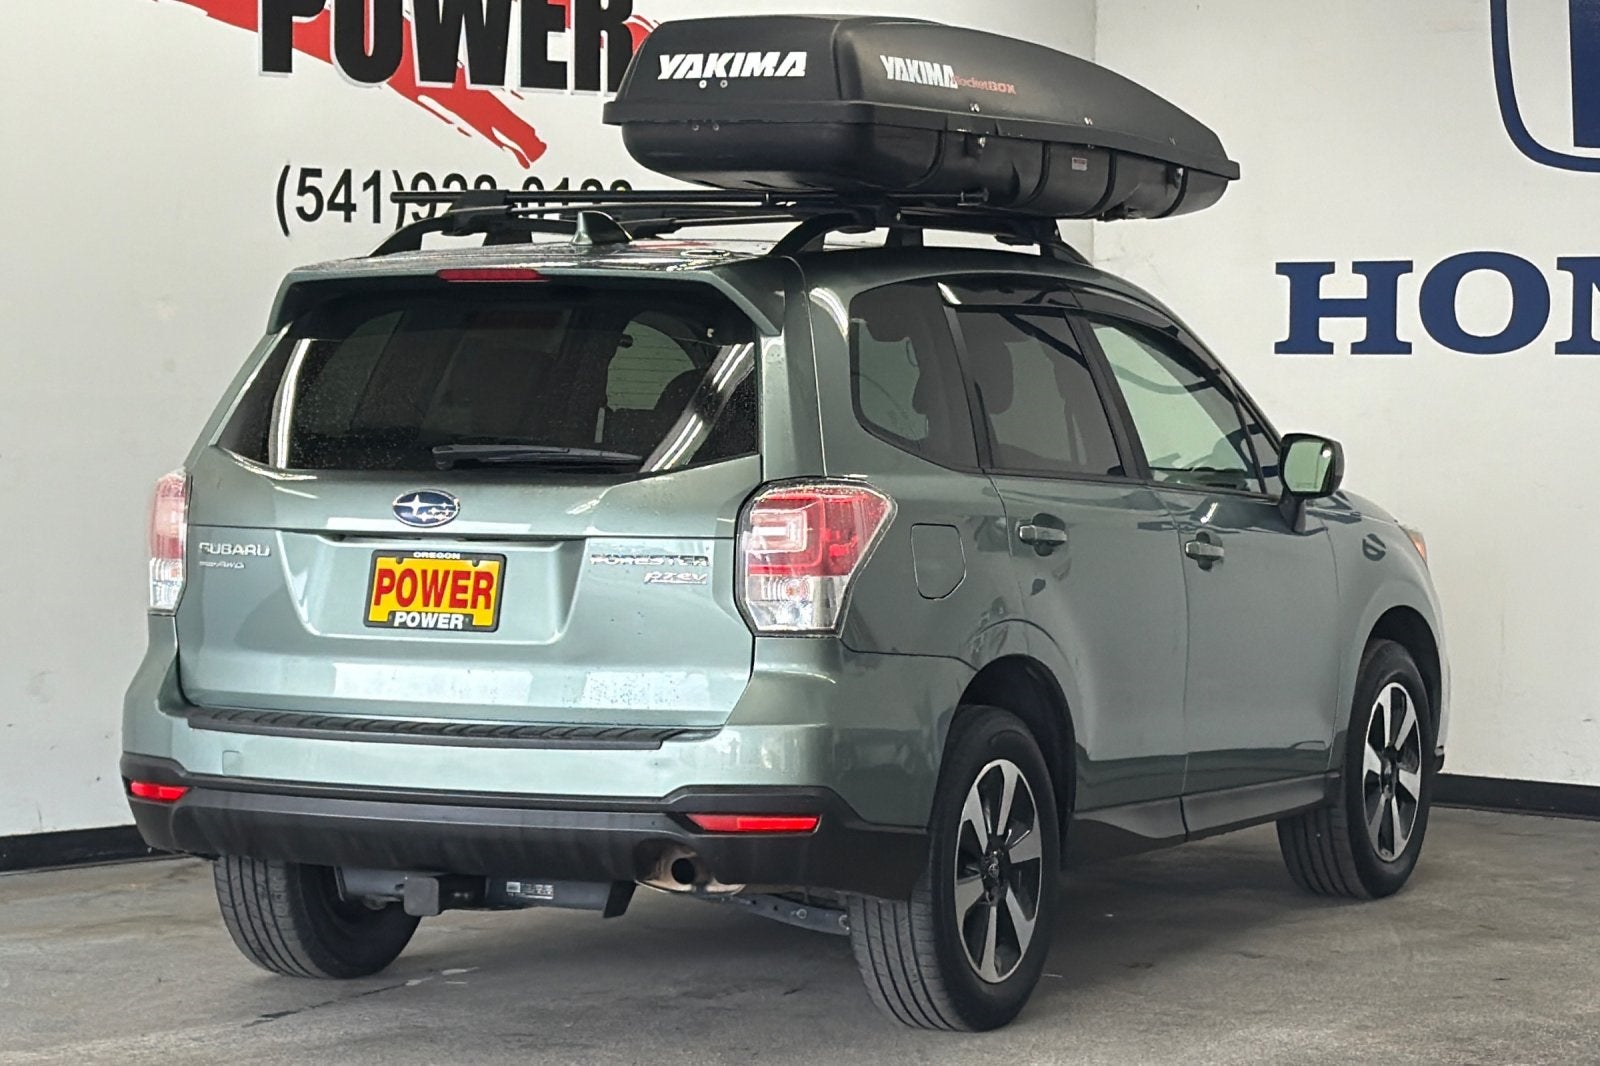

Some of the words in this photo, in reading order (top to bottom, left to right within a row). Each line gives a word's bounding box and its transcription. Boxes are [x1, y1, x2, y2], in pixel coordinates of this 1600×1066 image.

[657, 51, 807, 80] YAKIMA
[879, 55, 959, 89] YAKIMA
[199, 542, 271, 557] SUBARU
[413, 551, 461, 560] OREGON
[590, 555, 709, 567] FORESTER
[373, 568, 495, 610] POWER
[393, 611, 464, 630] POWER
